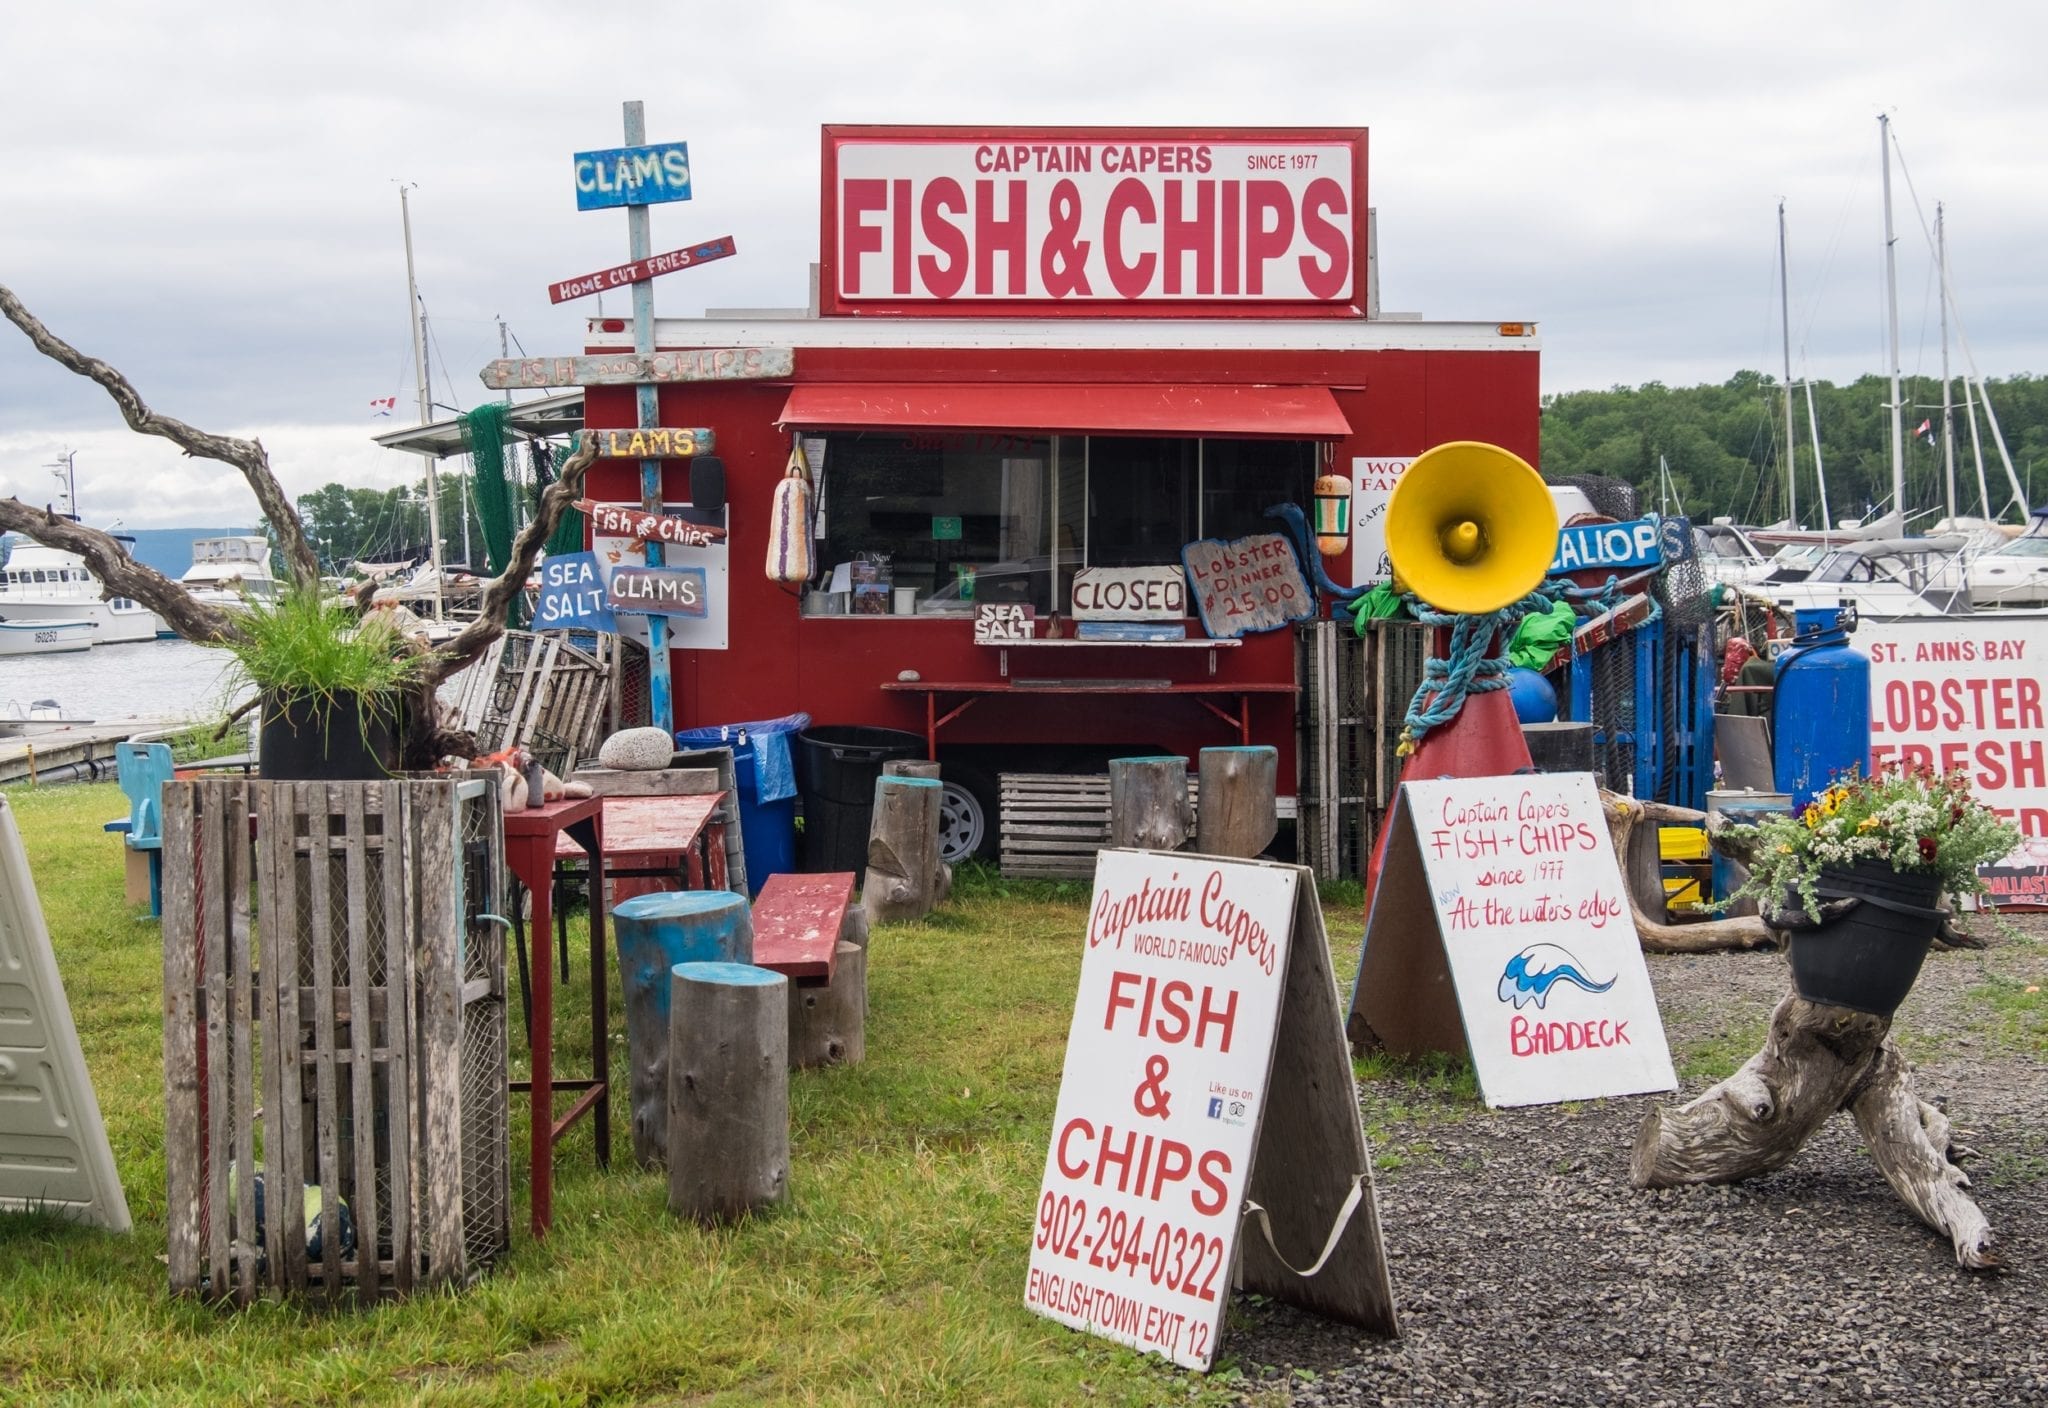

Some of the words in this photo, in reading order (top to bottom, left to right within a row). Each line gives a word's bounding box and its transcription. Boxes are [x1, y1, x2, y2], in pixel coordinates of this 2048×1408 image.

[575, 150, 690, 192] CLAMS
[975, 146, 1092, 173] CAPTAIN
[1101, 146, 1213, 174] CAPERS
[1247, 155, 1287, 170] SINCE
[1290, 155, 1319, 170] 1977
[560, 274, 604, 301] HOME
[610, 265, 638, 287] CUT
[647, 250, 691, 275] FRIES
[494, 356, 577, 386] FISH
[651, 348, 765, 381] CHIPS
[599, 429, 696, 457] LAMS
[591, 503, 632, 534] Fish
[548, 562, 594, 588] SEA
[612, 573, 697, 606] CLAMS
[541, 588, 603, 622] SALT
[1072, 579, 1184, 612] CLOSED
[975, 620, 1034, 640] SALT
[981, 604, 1026, 623] SEA
[1871, 643, 1906, 663] ST.
[1916, 640, 1976, 663] ANNS
[1984, 640, 2026, 662] BAY
[1442, 795, 1509, 827] Captain
[1430, 828, 1499, 860] FISH
[1519, 822, 1598, 855] CHIPS
[1475, 866, 1526, 887] since
[1534, 859, 1565, 882] 1977
[1090, 872, 1193, 950] Captain
[1200, 870, 1276, 977] Capers
[1448, 894, 1480, 930] At
[1484, 896, 1515, 926] the
[1578, 888, 1622, 930] edge
[1134, 932, 1177, 959] WORLD
[1180, 940, 1229, 968] FAMOUS
[1103, 970, 1240, 1054] FISH
[1510, 1014, 1631, 1057] BADDECK
[1133, 1053, 1173, 1121] &
[1208, 1080, 1227, 1096] Like
[1229, 1086, 1240, 1098] us
[1241, 1089, 1254, 1101] on
[1057, 1117, 1233, 1217] CHIPS
[1036, 1190, 1225, 1303] 902-294-0322
[1028, 1268, 1144, 1338] ENGLISHTOWN
[1143, 1304, 1186, 1350] EXIT
[1188, 1318, 1209, 1358] 12
